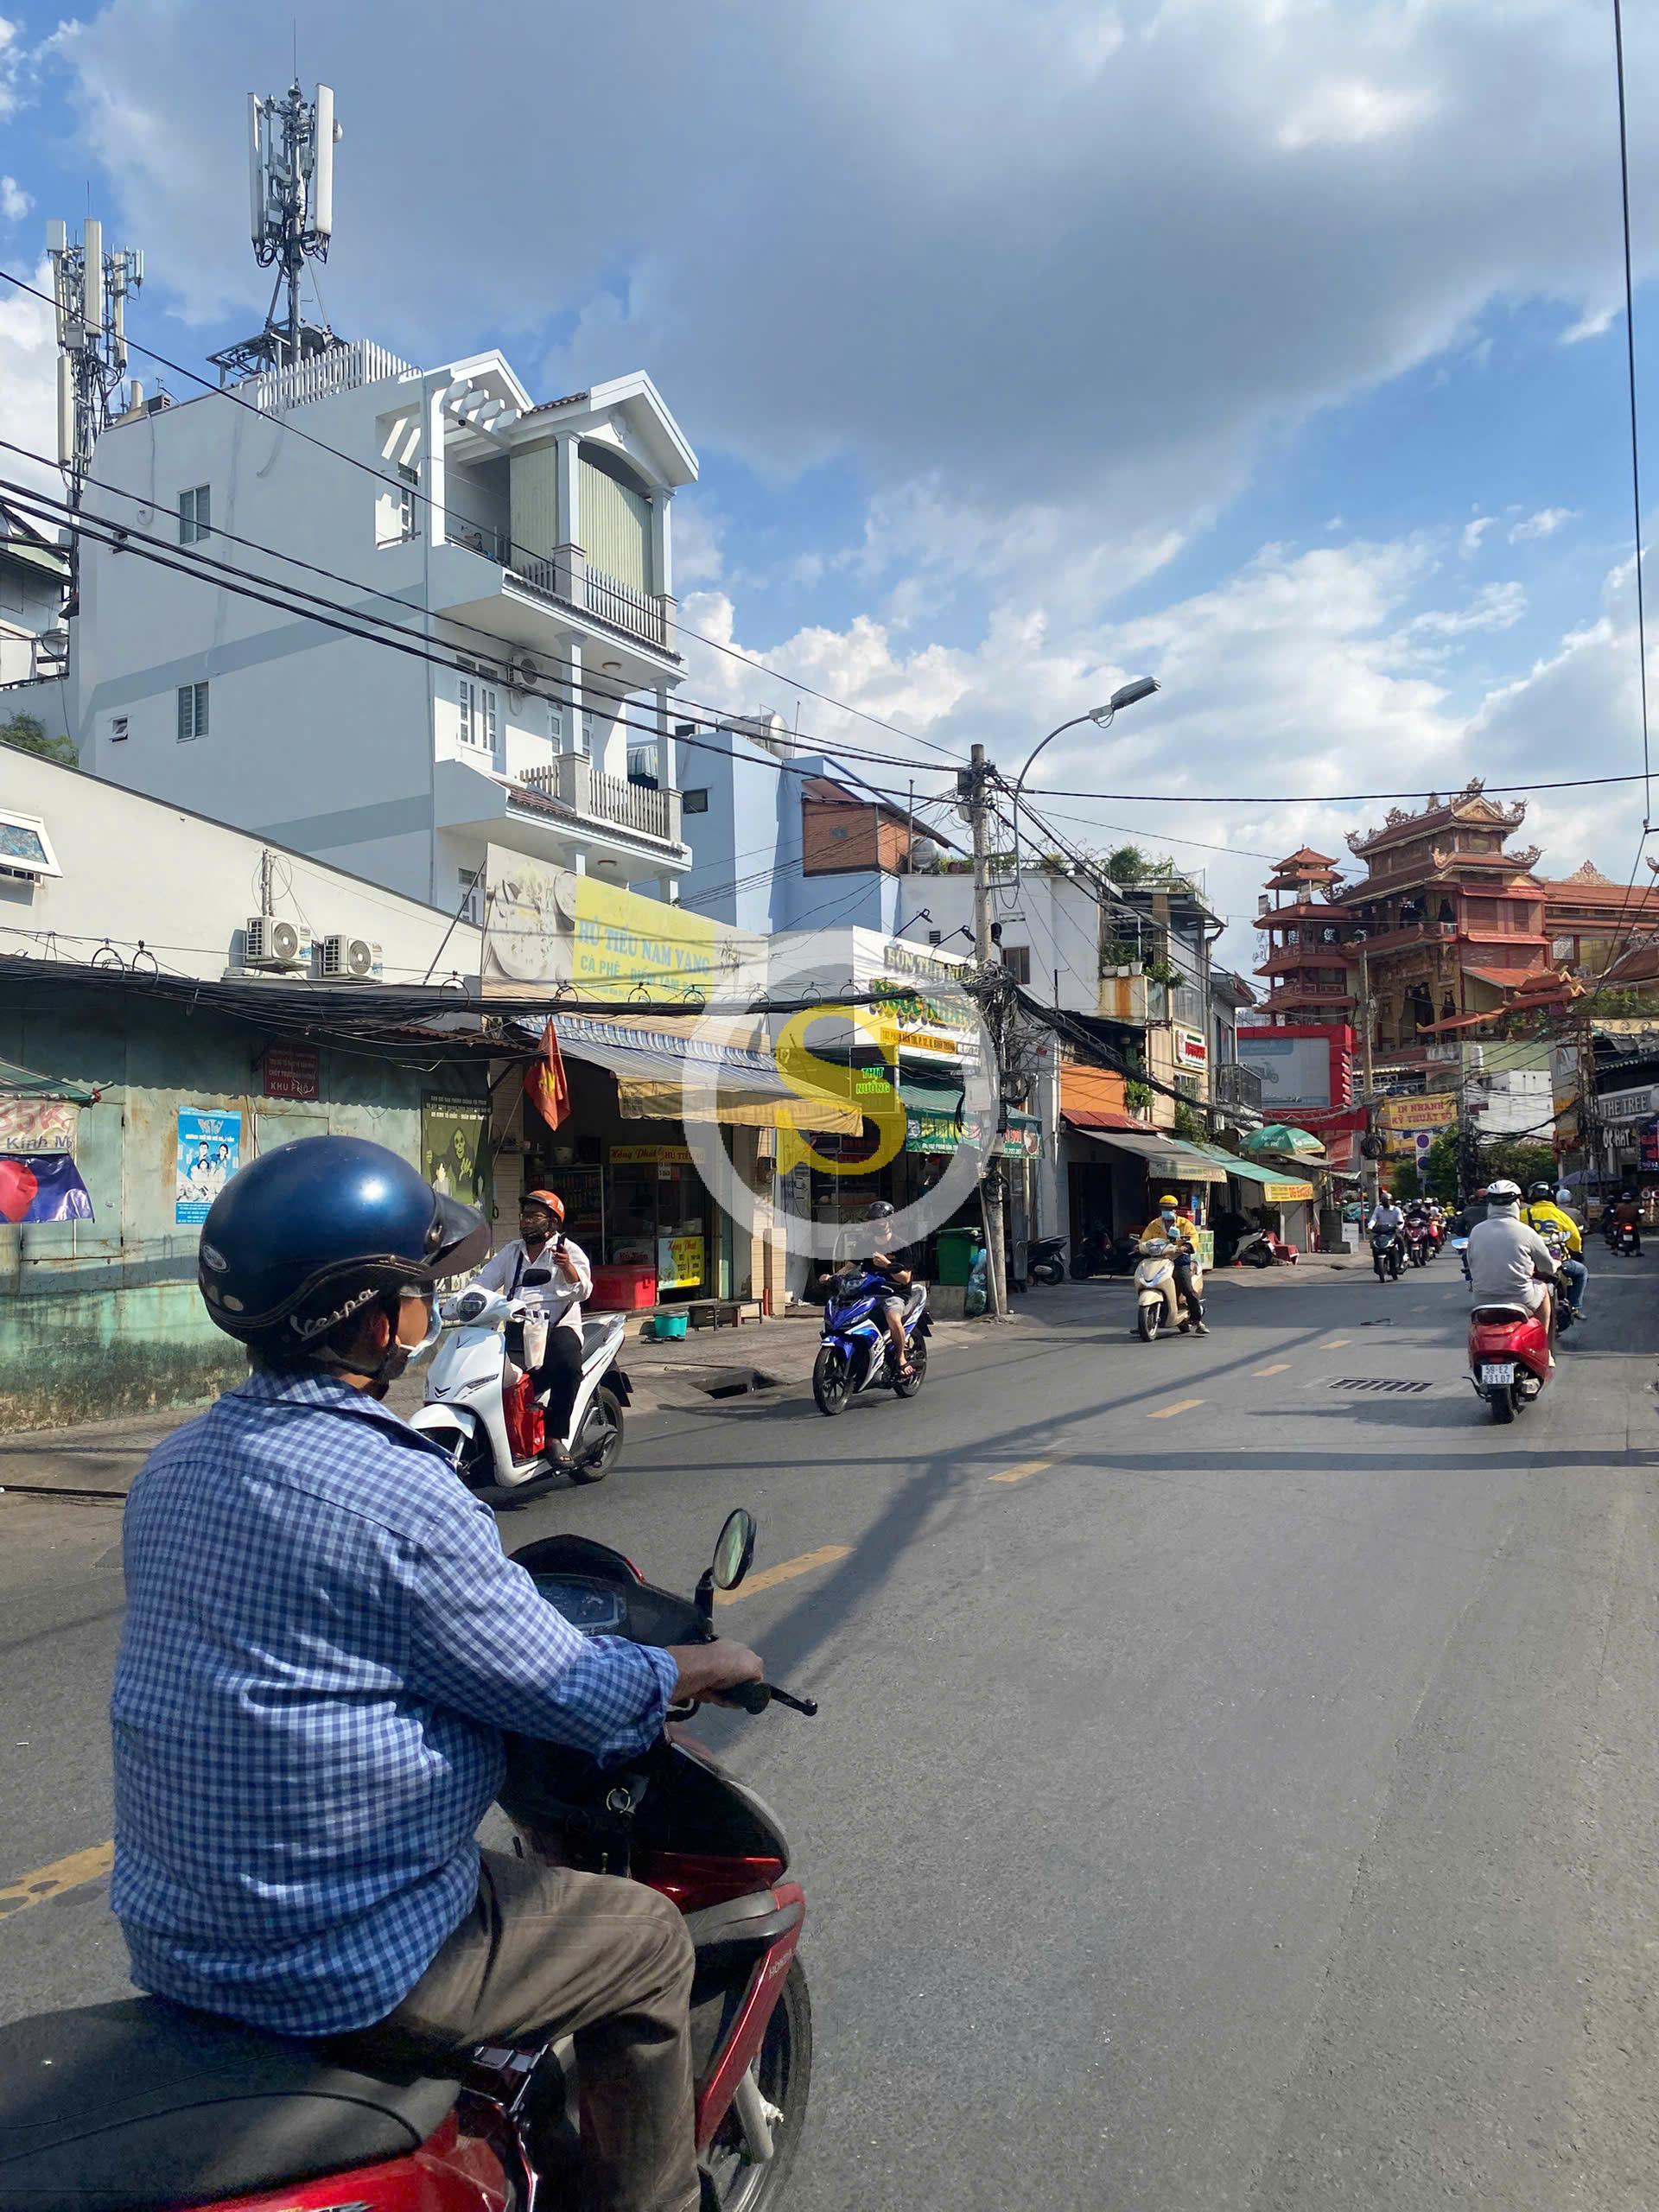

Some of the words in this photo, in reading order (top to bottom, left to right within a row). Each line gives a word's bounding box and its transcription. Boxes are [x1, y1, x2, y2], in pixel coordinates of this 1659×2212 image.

[270, 1082, 289, 1091] KHU
[1411, 1102, 1444, 1112] NHANH
[1603, 1098, 1621, 1117] THE
[1622, 1095, 1647, 1114] TREE
